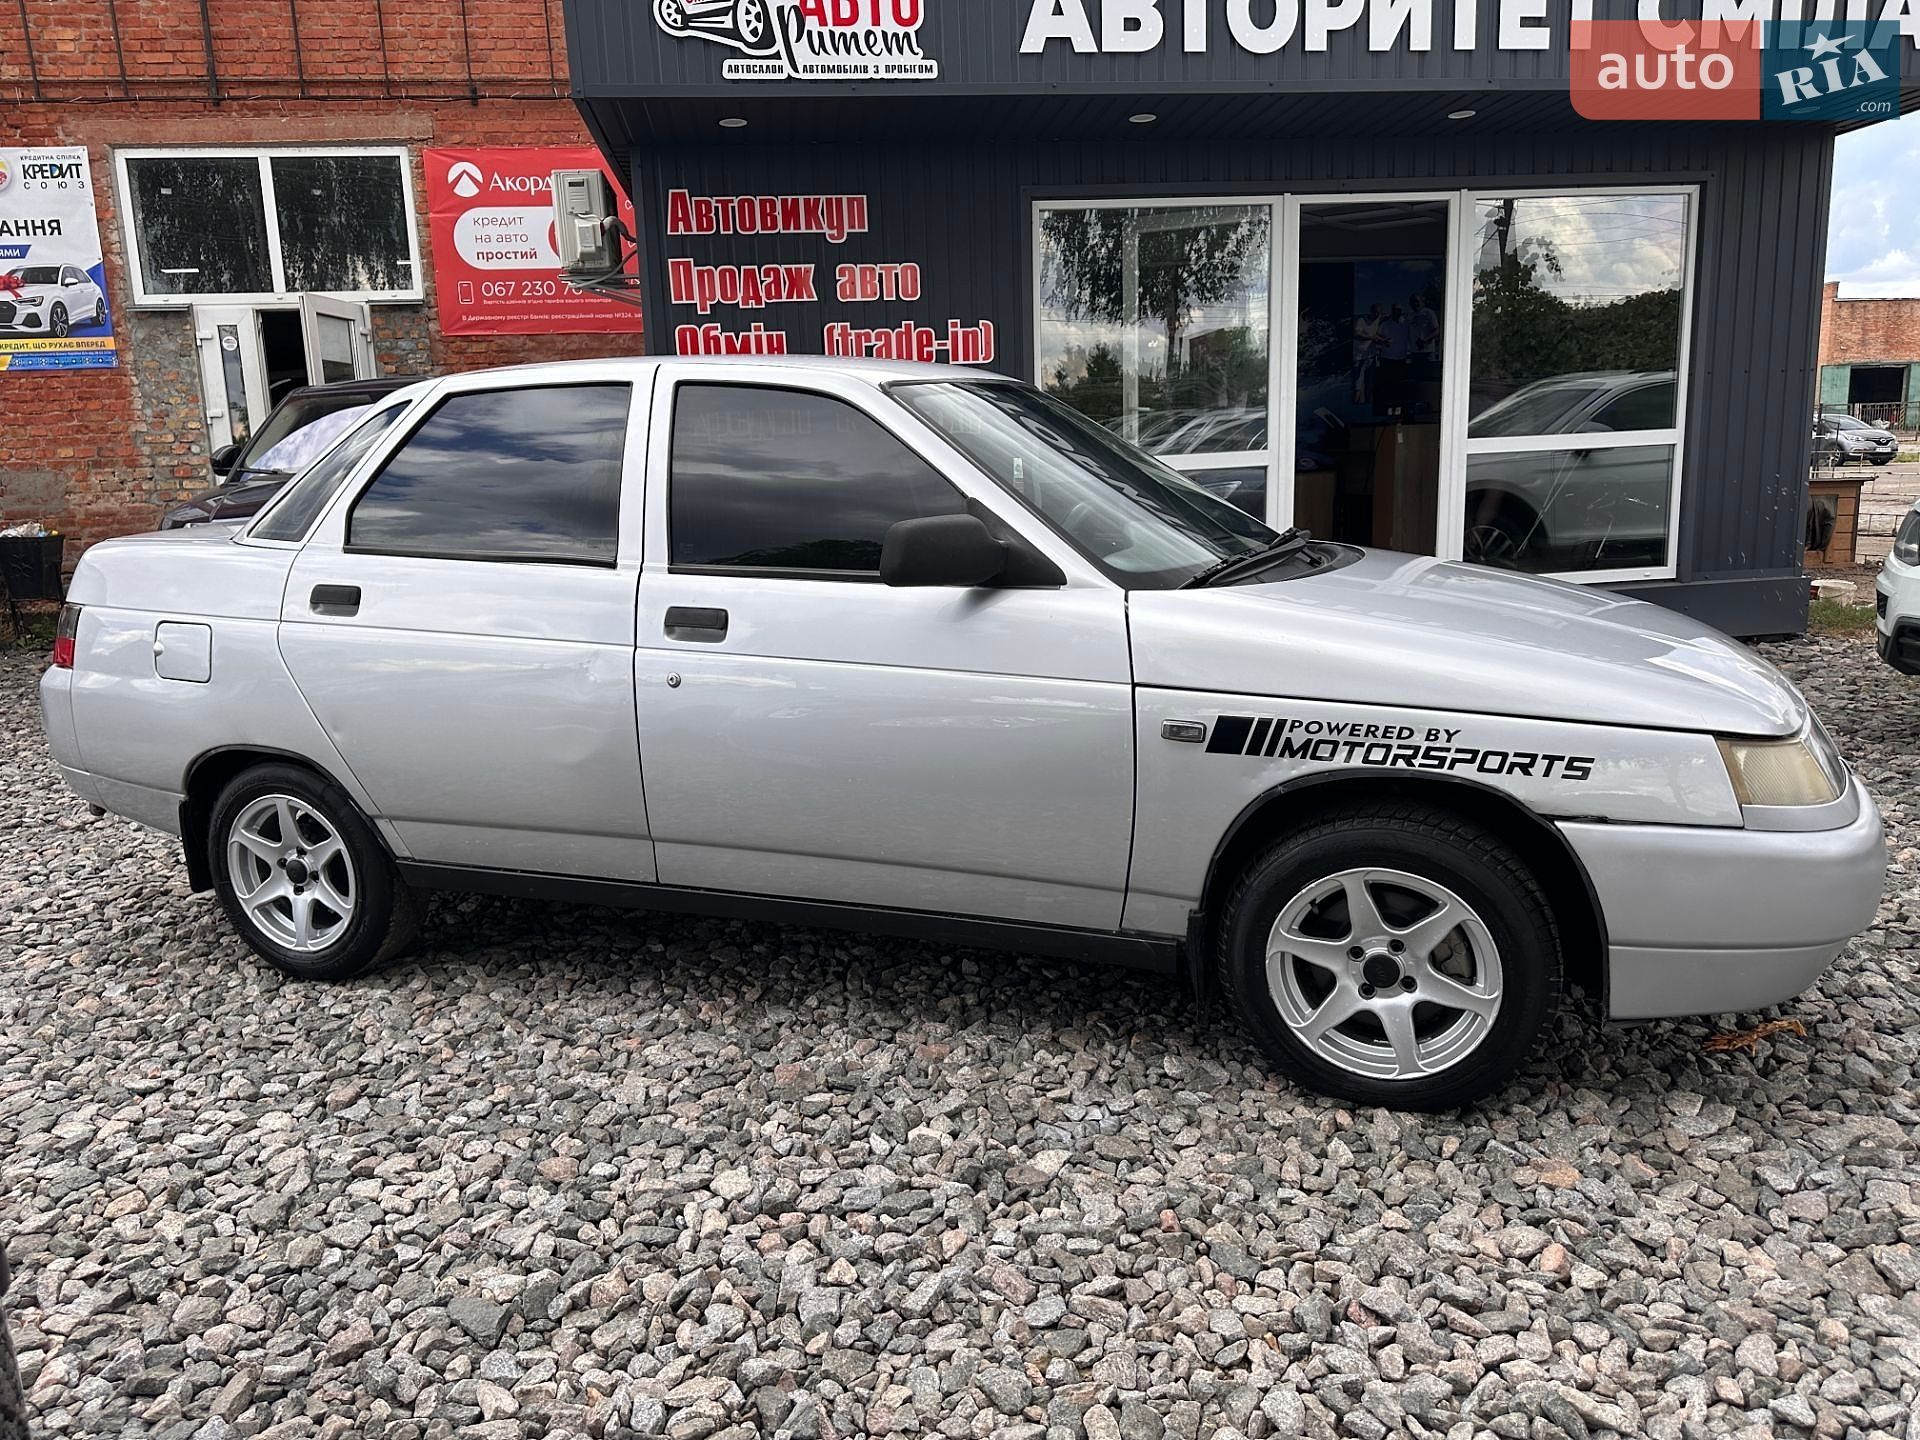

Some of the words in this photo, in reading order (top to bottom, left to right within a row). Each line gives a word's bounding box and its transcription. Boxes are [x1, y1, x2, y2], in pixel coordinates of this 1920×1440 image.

[727, 64, 784, 74] АВТОСАЛОН
[802, 64, 869, 74] АВТОМОБІЛІВ
[884, 64, 934, 74] ПРОБІГОМ
[23, 181, 85, 190] СОЮЗ
[473, 216, 525, 227] кредит
[668, 189, 868, 243] Автовикуп
[475, 234, 492, 243] на
[496, 233, 529, 243] авто
[476, 248, 538, 262] простий
[481, 281, 516, 297] 067
[522, 280, 556, 296] 230
[668, 258, 818, 314] Продаж
[836, 263, 921, 302] авто
[33, 342, 47, 350] ЩО
[76, 340, 106, 348] ВПЕРЕД
[675, 323, 787, 355] Обмін
[823, 319, 995, 365] (trade-in)
[1288, 719, 1416, 742] POWERED
[1425, 728, 1463, 743] BY
[1278, 736, 1595, 781] MOTORSPORTS
